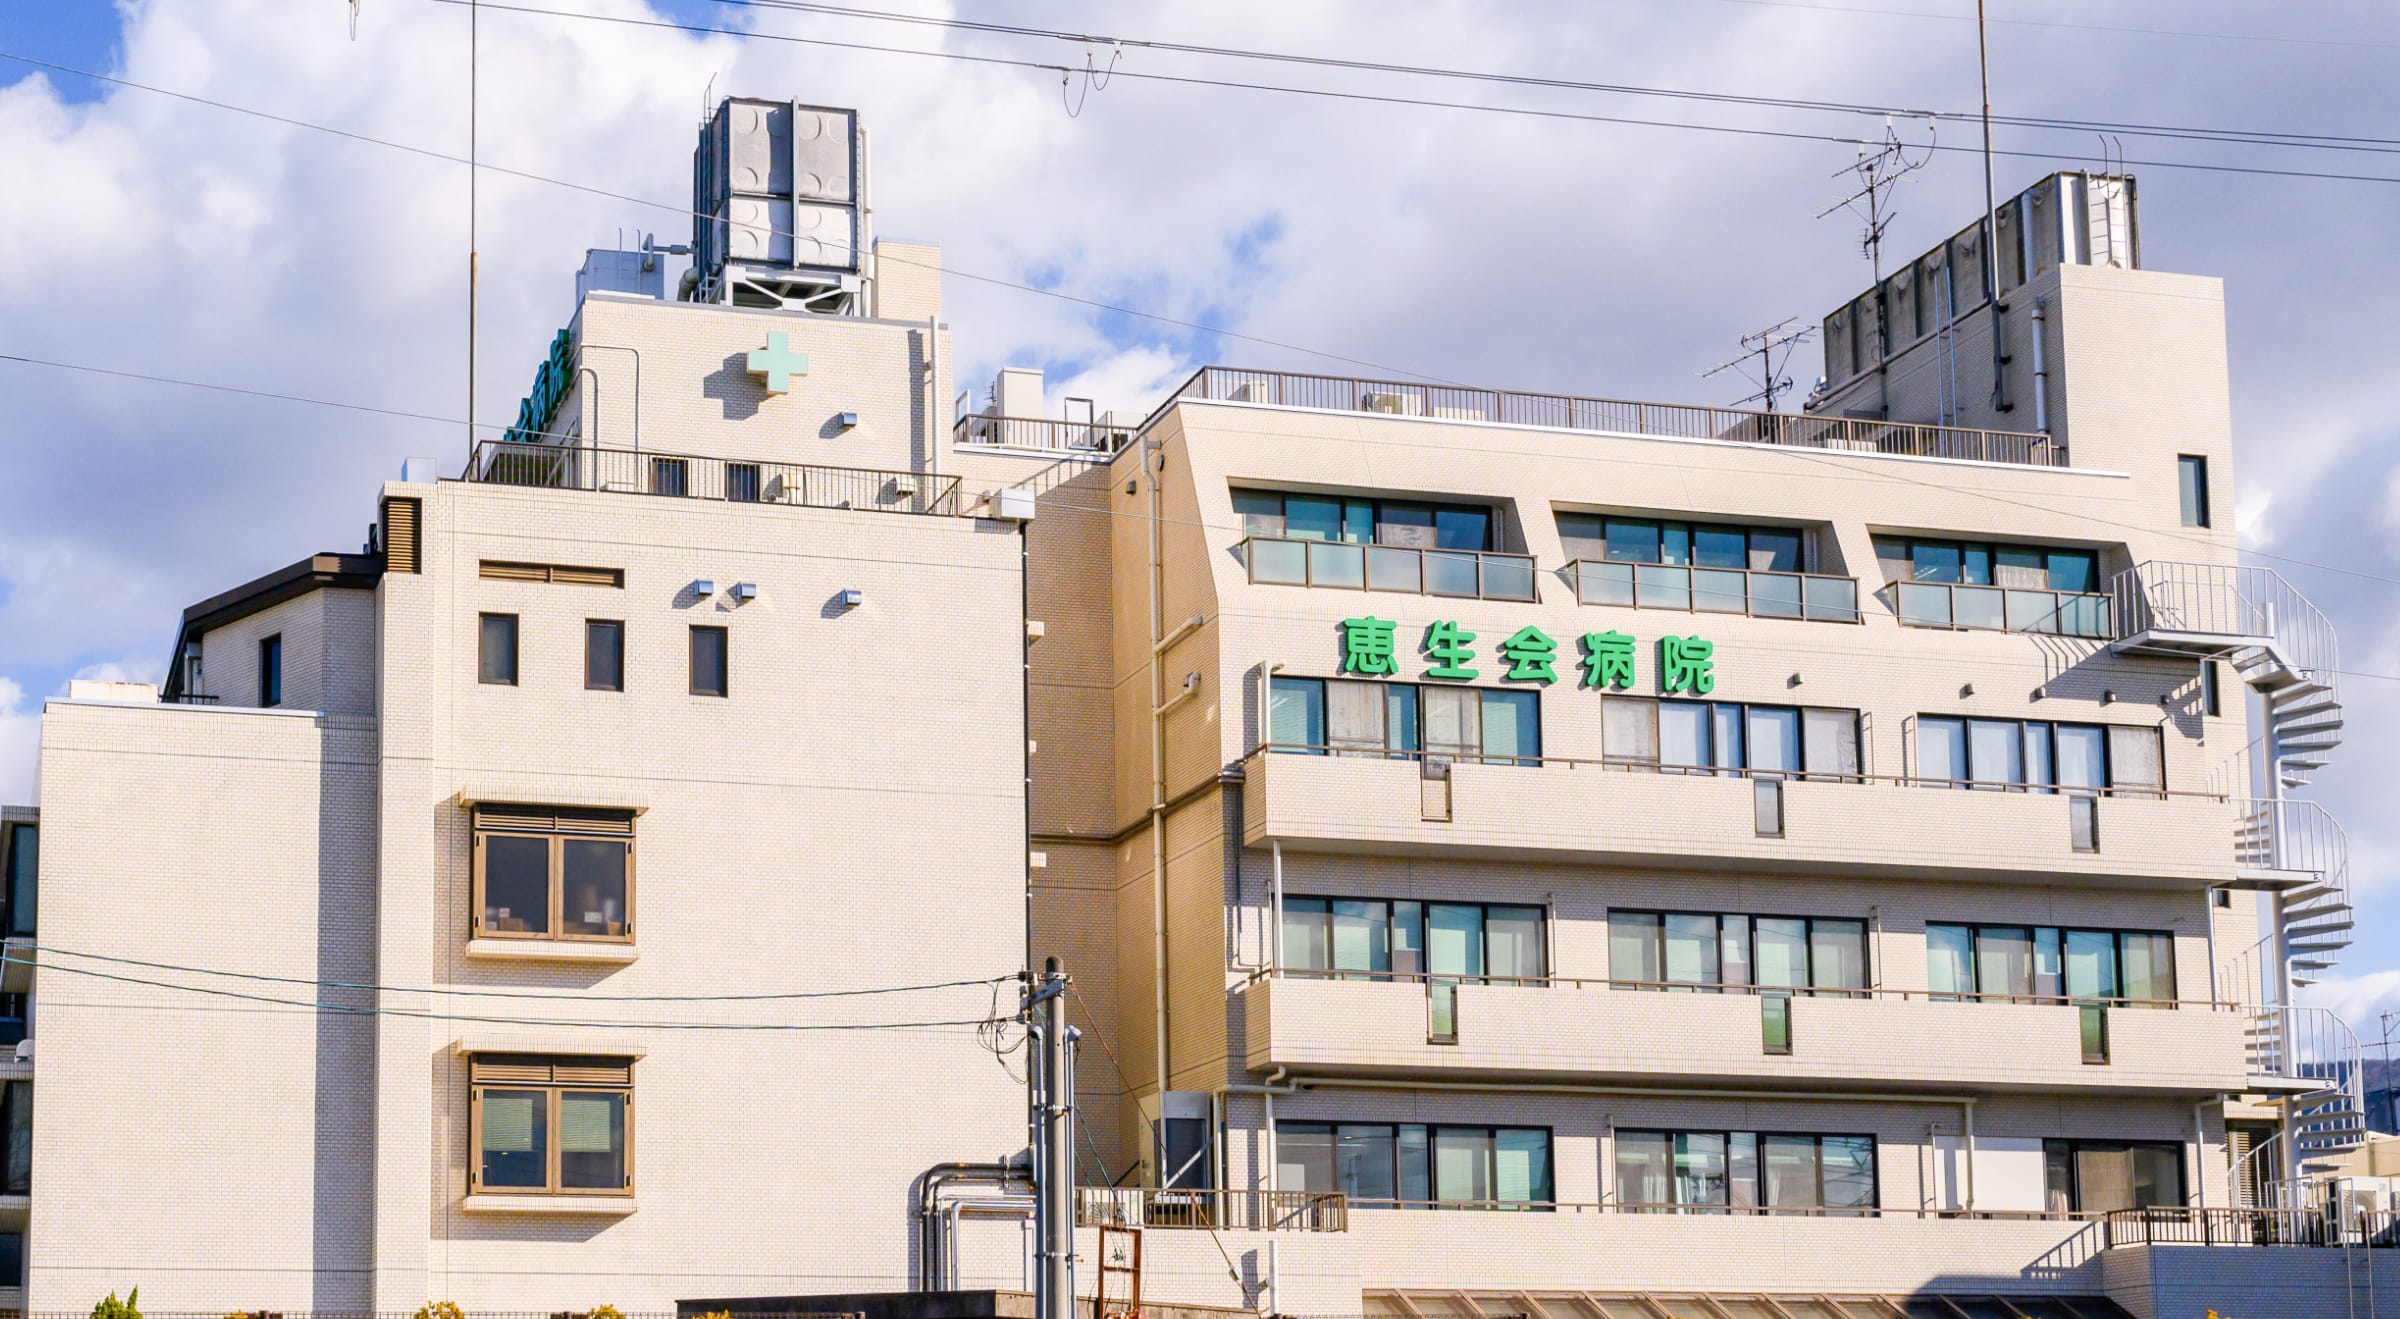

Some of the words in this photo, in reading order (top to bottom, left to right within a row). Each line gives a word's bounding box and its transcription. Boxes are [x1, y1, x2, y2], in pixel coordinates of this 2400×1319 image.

[1343, 615, 1715, 694] 恵生会病院
